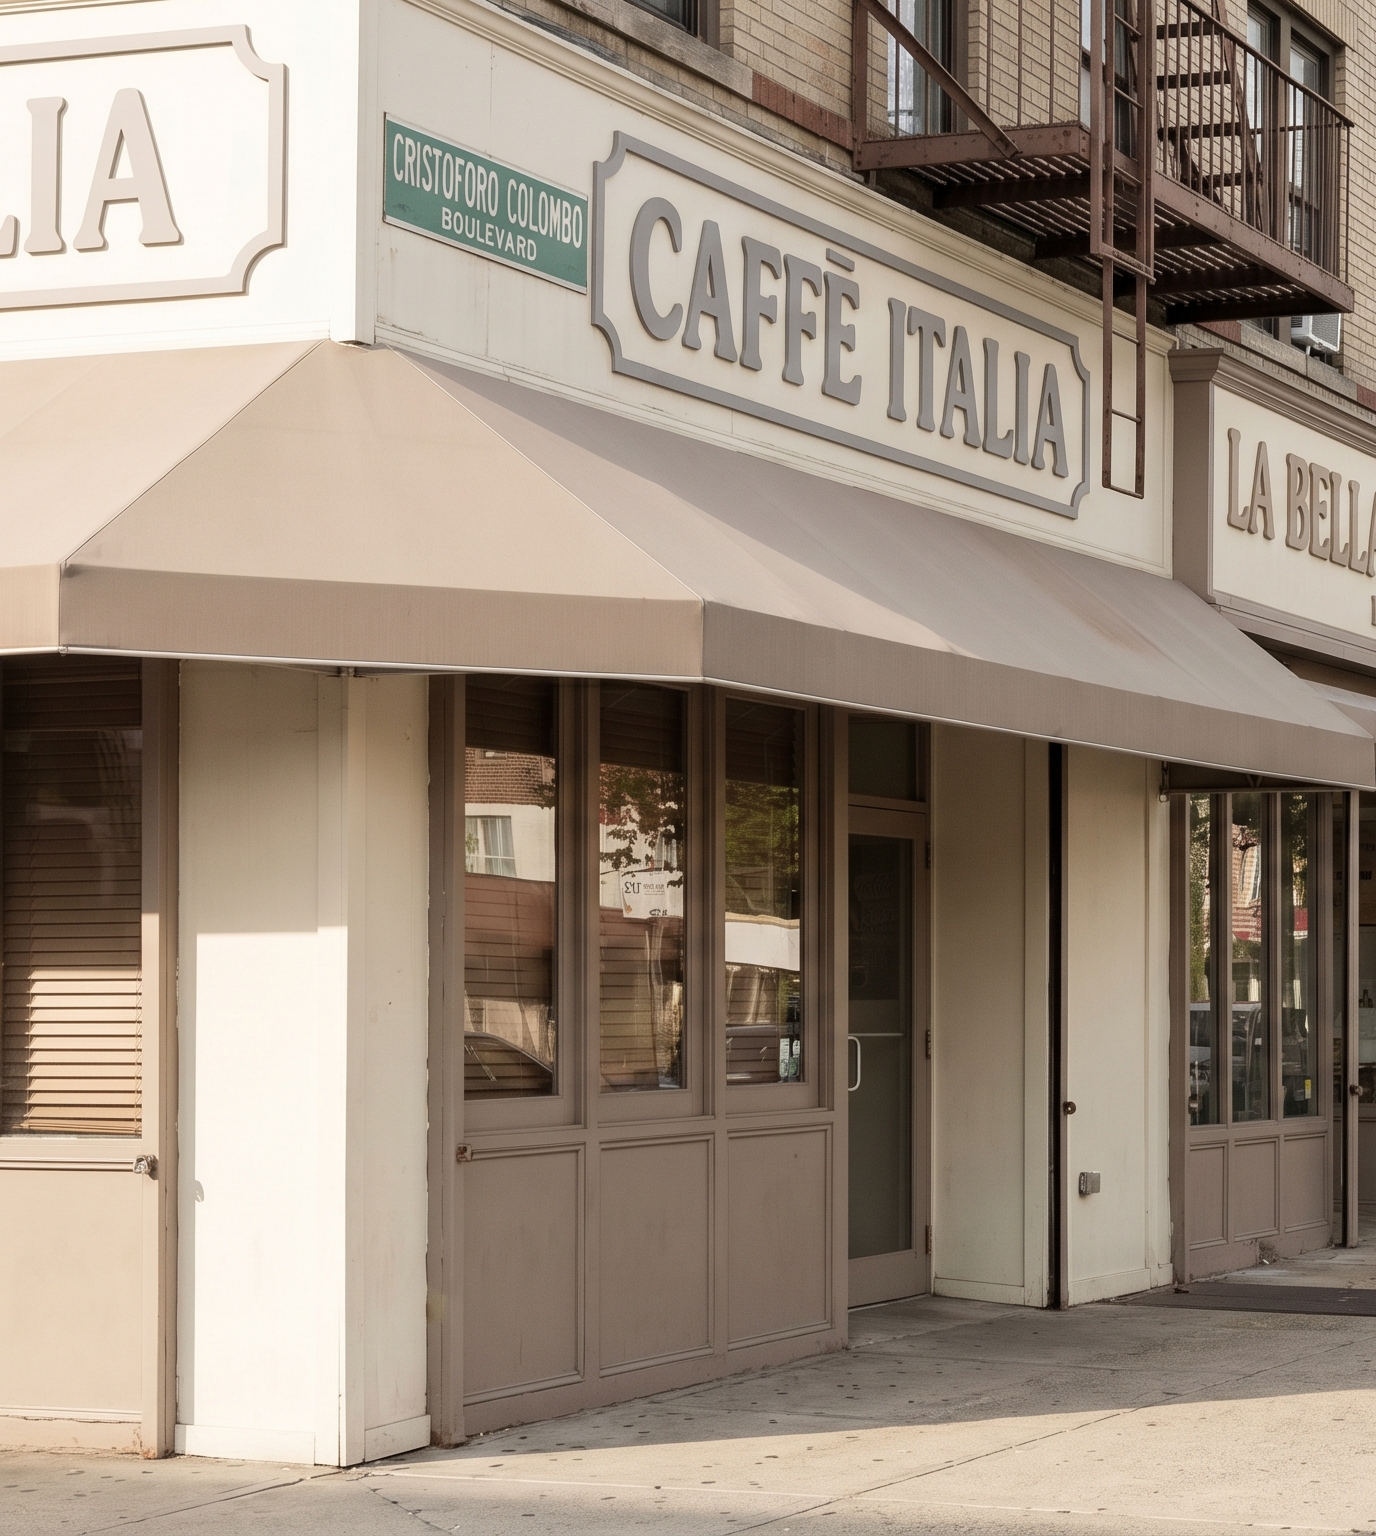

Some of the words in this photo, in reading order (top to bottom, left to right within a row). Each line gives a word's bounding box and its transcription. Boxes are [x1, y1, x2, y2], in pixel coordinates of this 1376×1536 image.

[0, 87, 184, 258] IA
[393, 133, 499, 217] CRISTOFORO
[507, 178, 583, 248] COLOMBO
[441, 206, 537, 261] BOULEVARD
[887, 297, 1069, 478] ITALIA
[1227, 427, 1275, 540] LA
